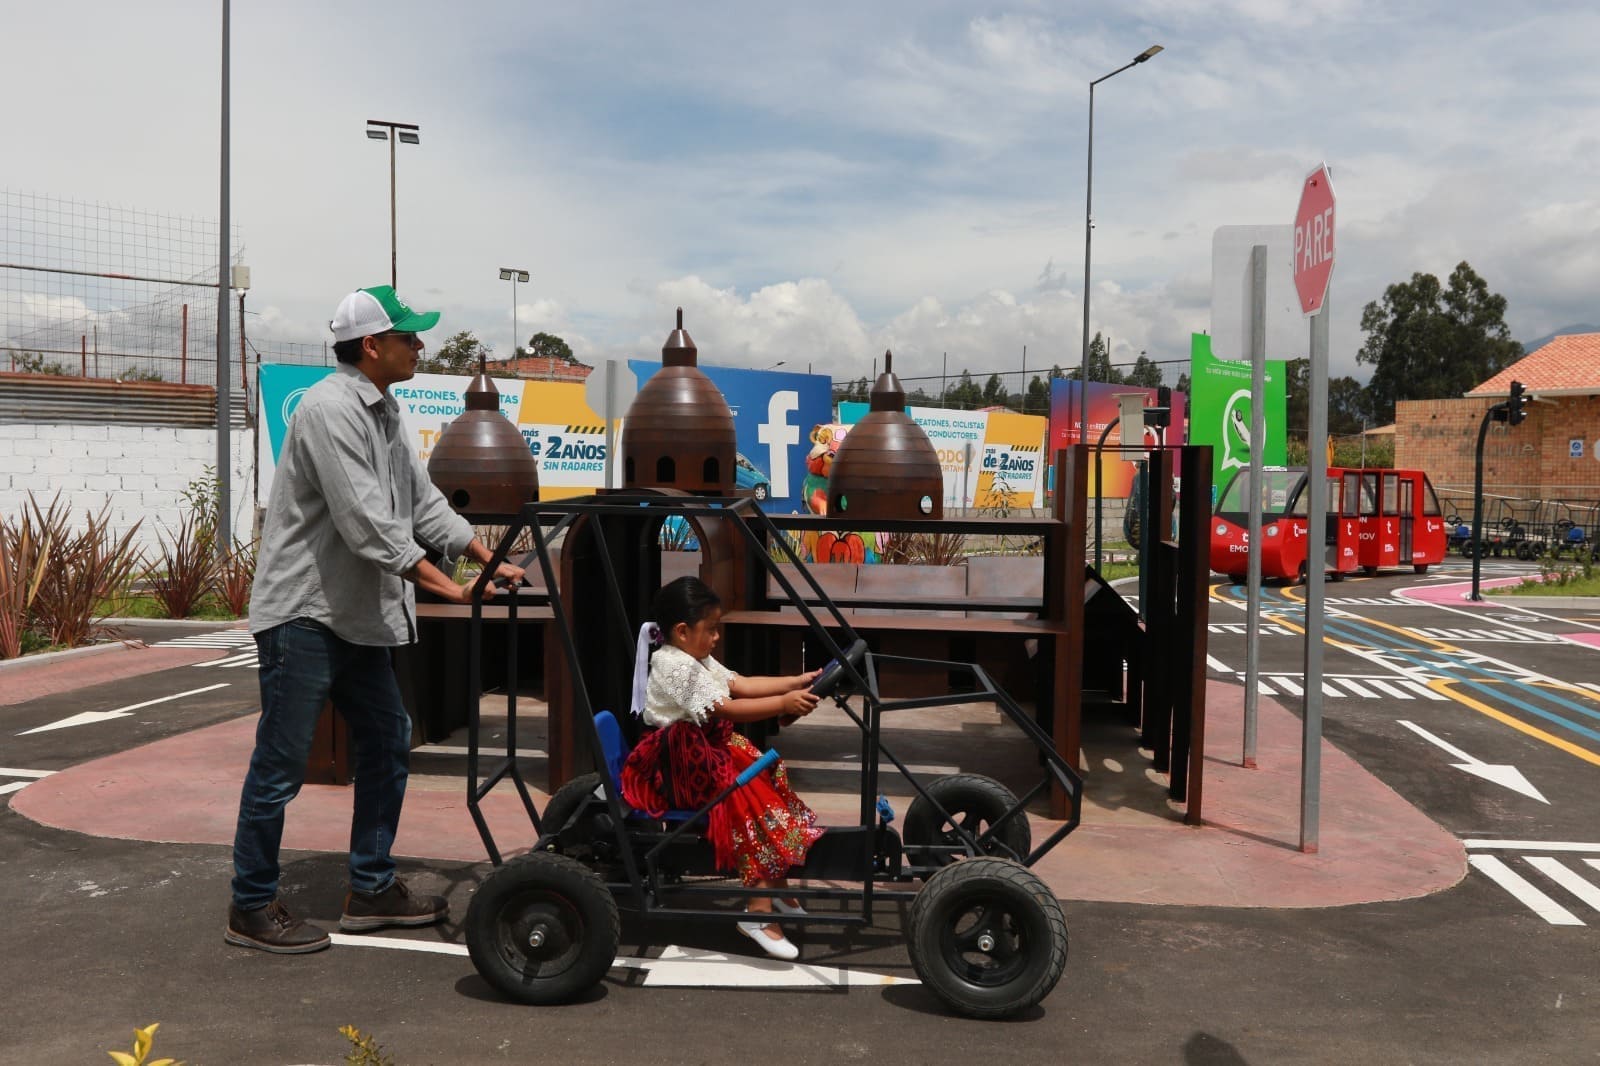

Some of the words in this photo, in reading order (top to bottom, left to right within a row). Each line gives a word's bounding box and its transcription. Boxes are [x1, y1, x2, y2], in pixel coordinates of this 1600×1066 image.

[1295, 207, 1333, 276] PARE
[394, 388, 460, 402] PEATONES,
[408, 404, 416, 414] Y
[418, 405, 509, 419] CONDUS:
[952, 421, 985, 430] CICLISTAS
[543, 461, 559, 470] SIN
[561, 461, 603, 472] RADARES
[983, 454, 997, 468] de
[1229, 544, 1249, 553] EMO
